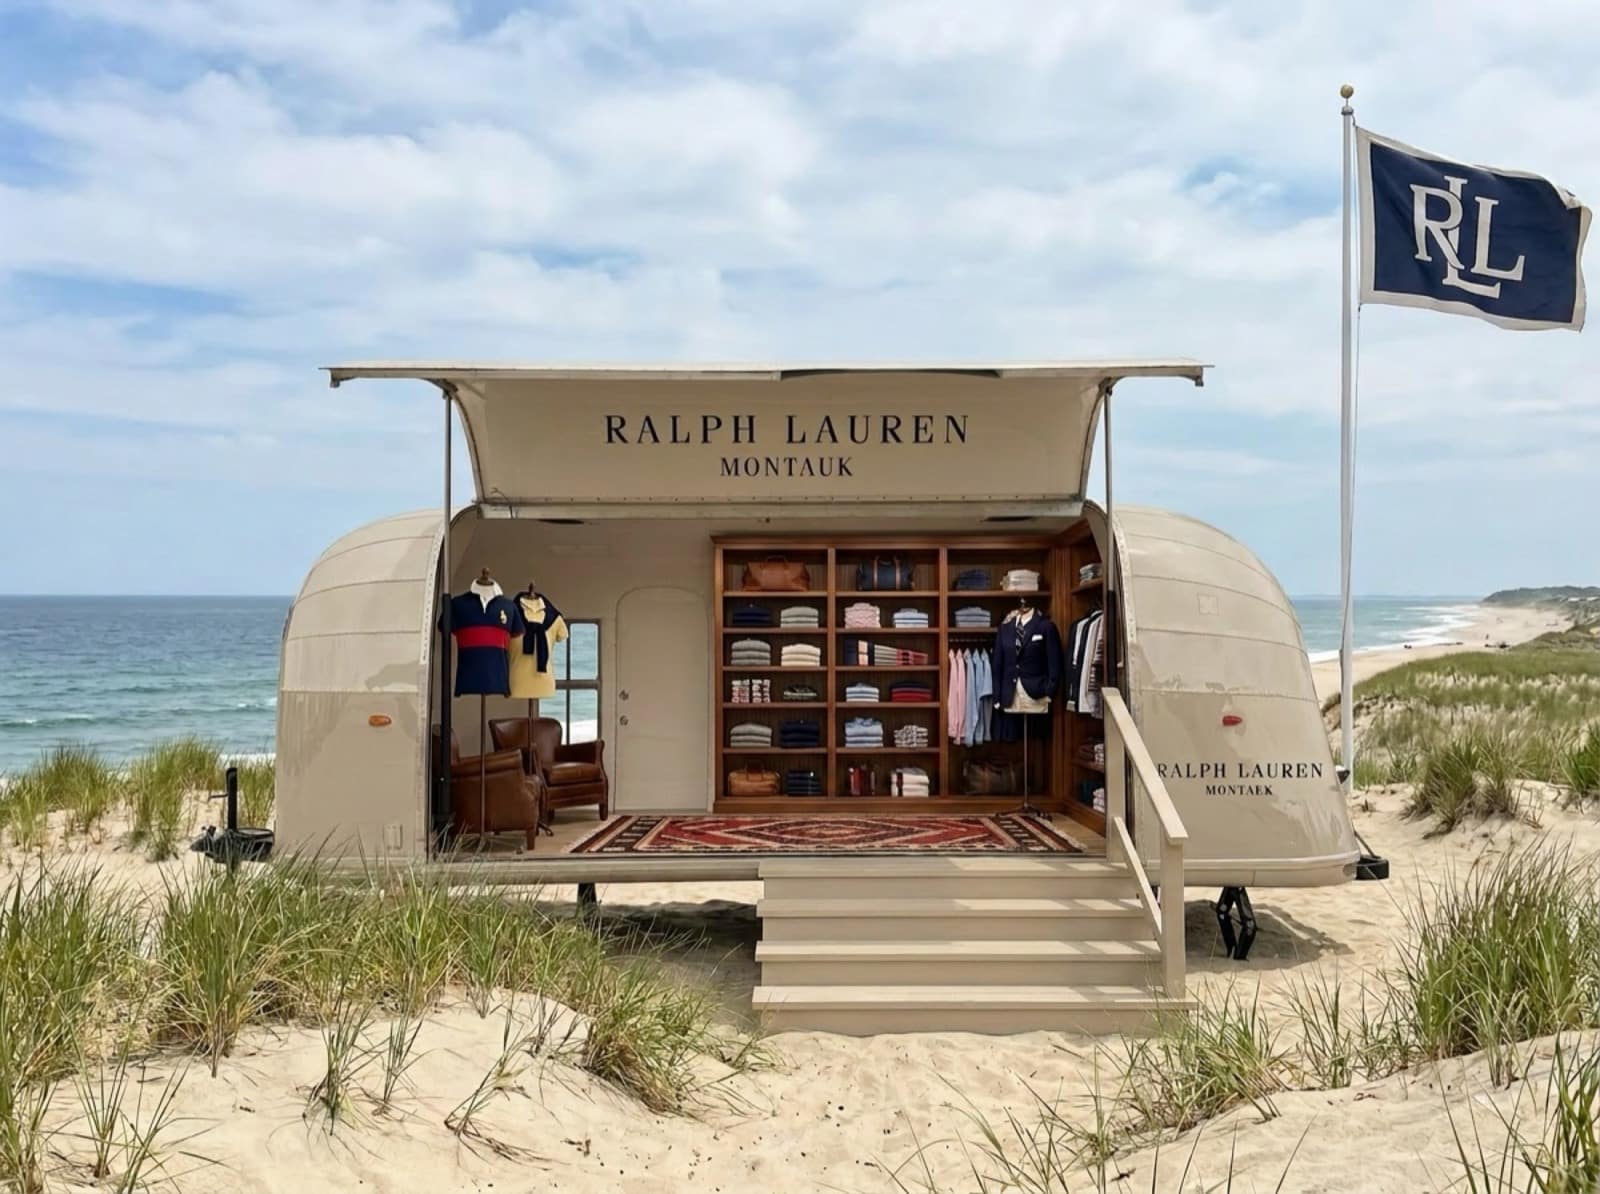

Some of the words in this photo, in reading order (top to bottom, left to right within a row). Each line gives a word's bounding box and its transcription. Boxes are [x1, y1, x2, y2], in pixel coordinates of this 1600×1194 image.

[604, 414, 757, 444] RALPH
[785, 414, 969, 444] LAUREN
[720, 456, 854, 477] MONTAUK
[1157, 762, 1227, 778] RALPH
[1238, 762, 1323, 778] LAUREN
